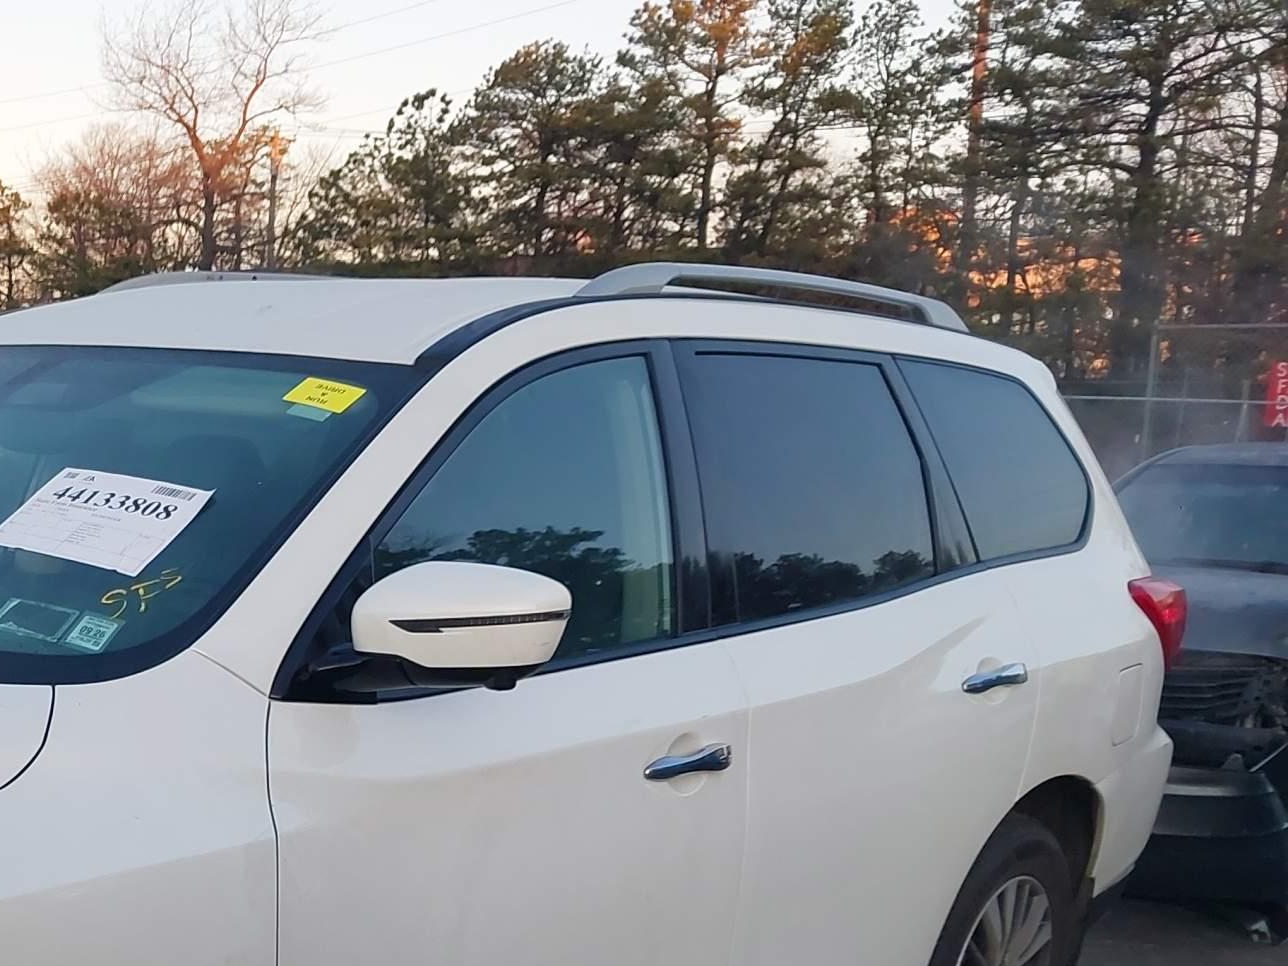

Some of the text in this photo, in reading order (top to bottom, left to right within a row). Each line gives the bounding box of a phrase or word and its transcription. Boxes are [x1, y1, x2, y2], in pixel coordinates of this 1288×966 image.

[53, 486, 178, 521] 44133808
[80, 625, 94, 636] 09
[94, 629, 106, 639] 26
